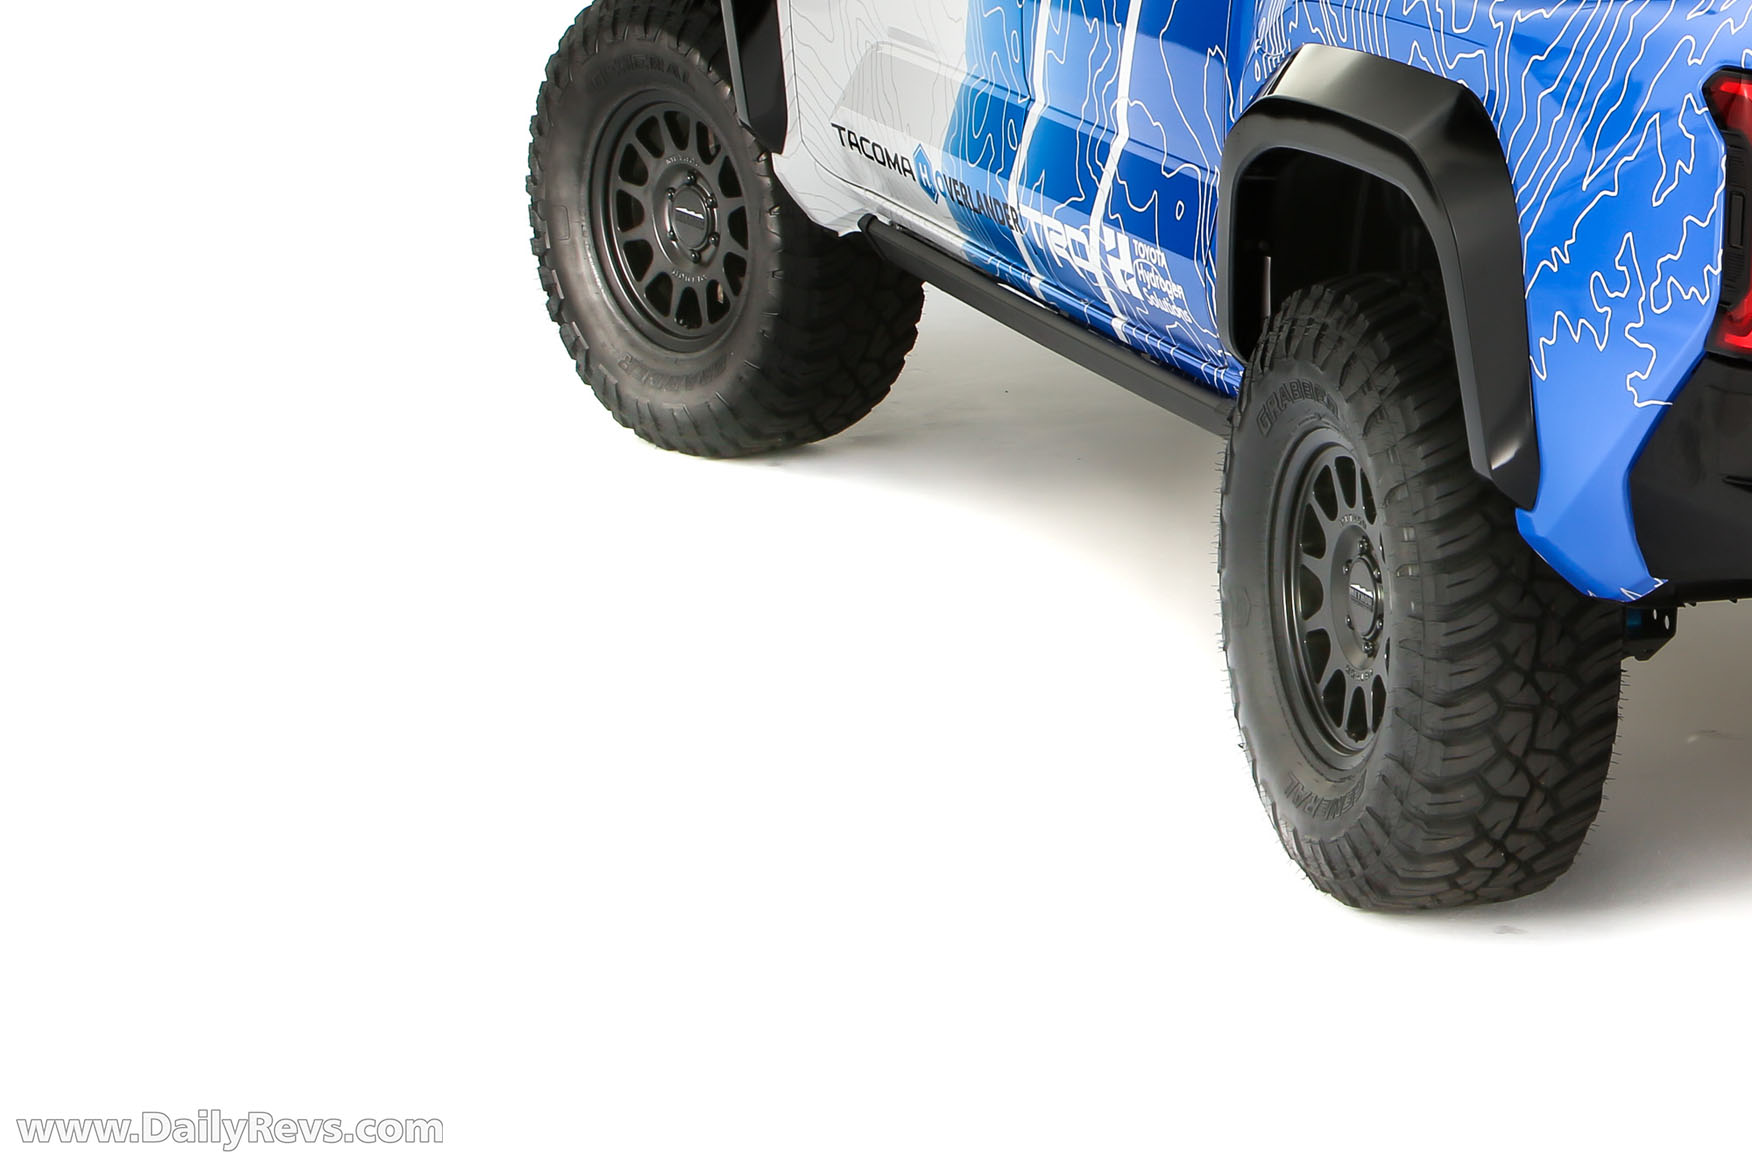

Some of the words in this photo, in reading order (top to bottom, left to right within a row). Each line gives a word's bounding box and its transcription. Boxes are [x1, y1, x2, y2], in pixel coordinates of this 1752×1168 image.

[831, 122, 916, 182] TACOMA
[1132, 238, 1167, 268] TOYOTA
[1136, 262, 1185, 302] Hydrogen
[1142, 287, 1193, 323] Solutions
